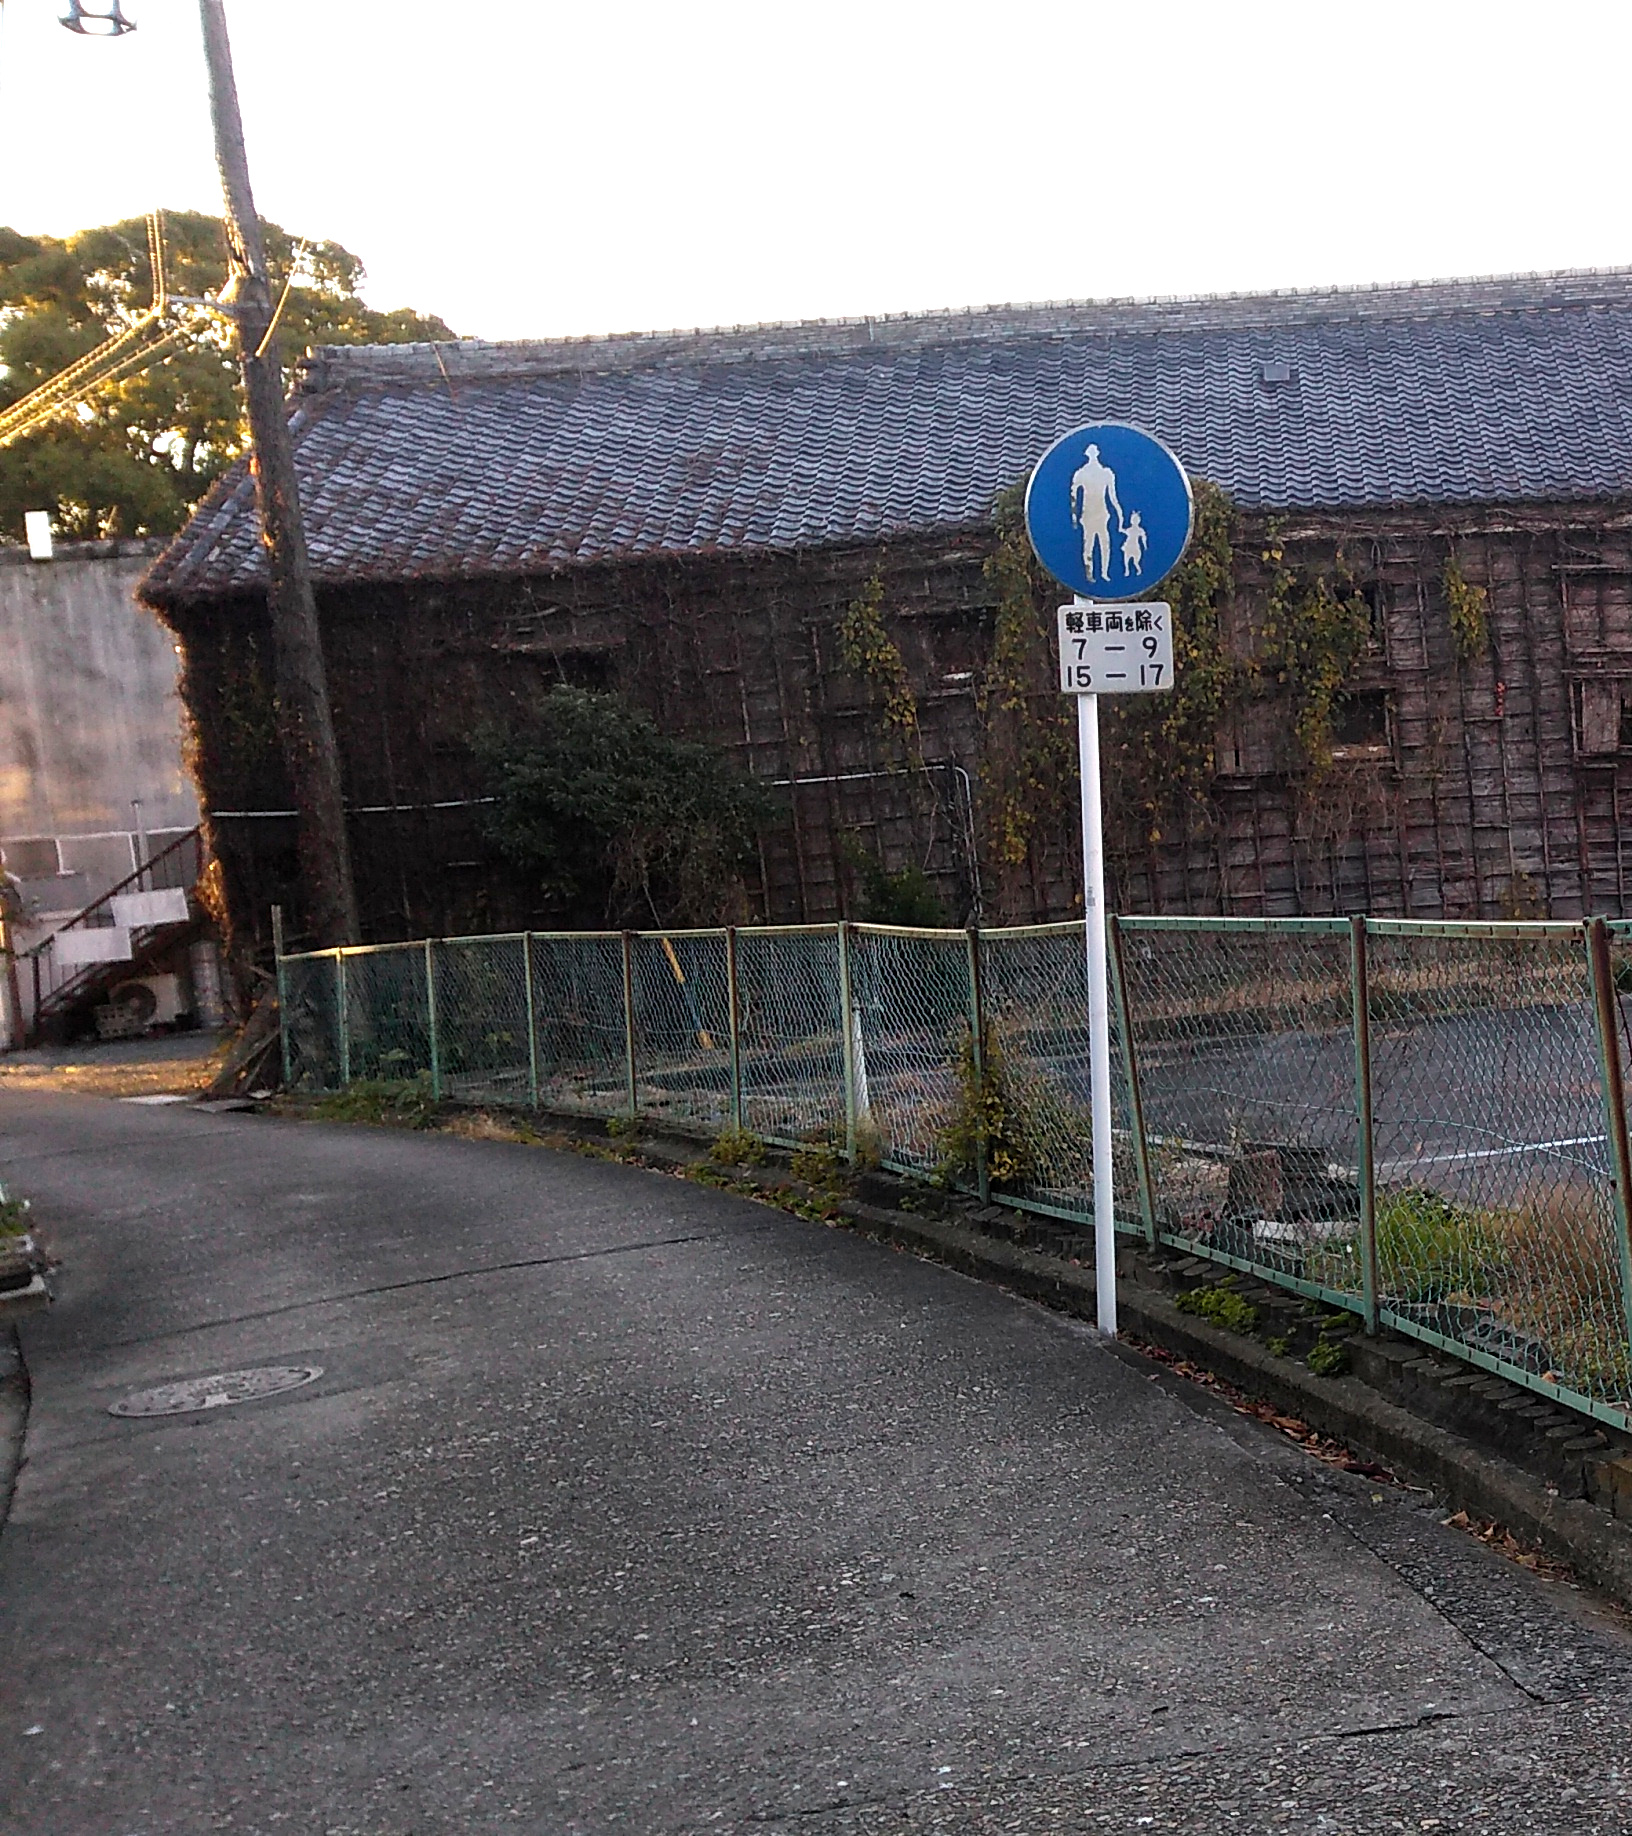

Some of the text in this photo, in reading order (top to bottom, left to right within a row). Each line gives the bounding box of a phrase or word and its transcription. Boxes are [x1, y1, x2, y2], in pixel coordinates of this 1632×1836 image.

[1065, 609, 1163, 633] 軽車両を除く
